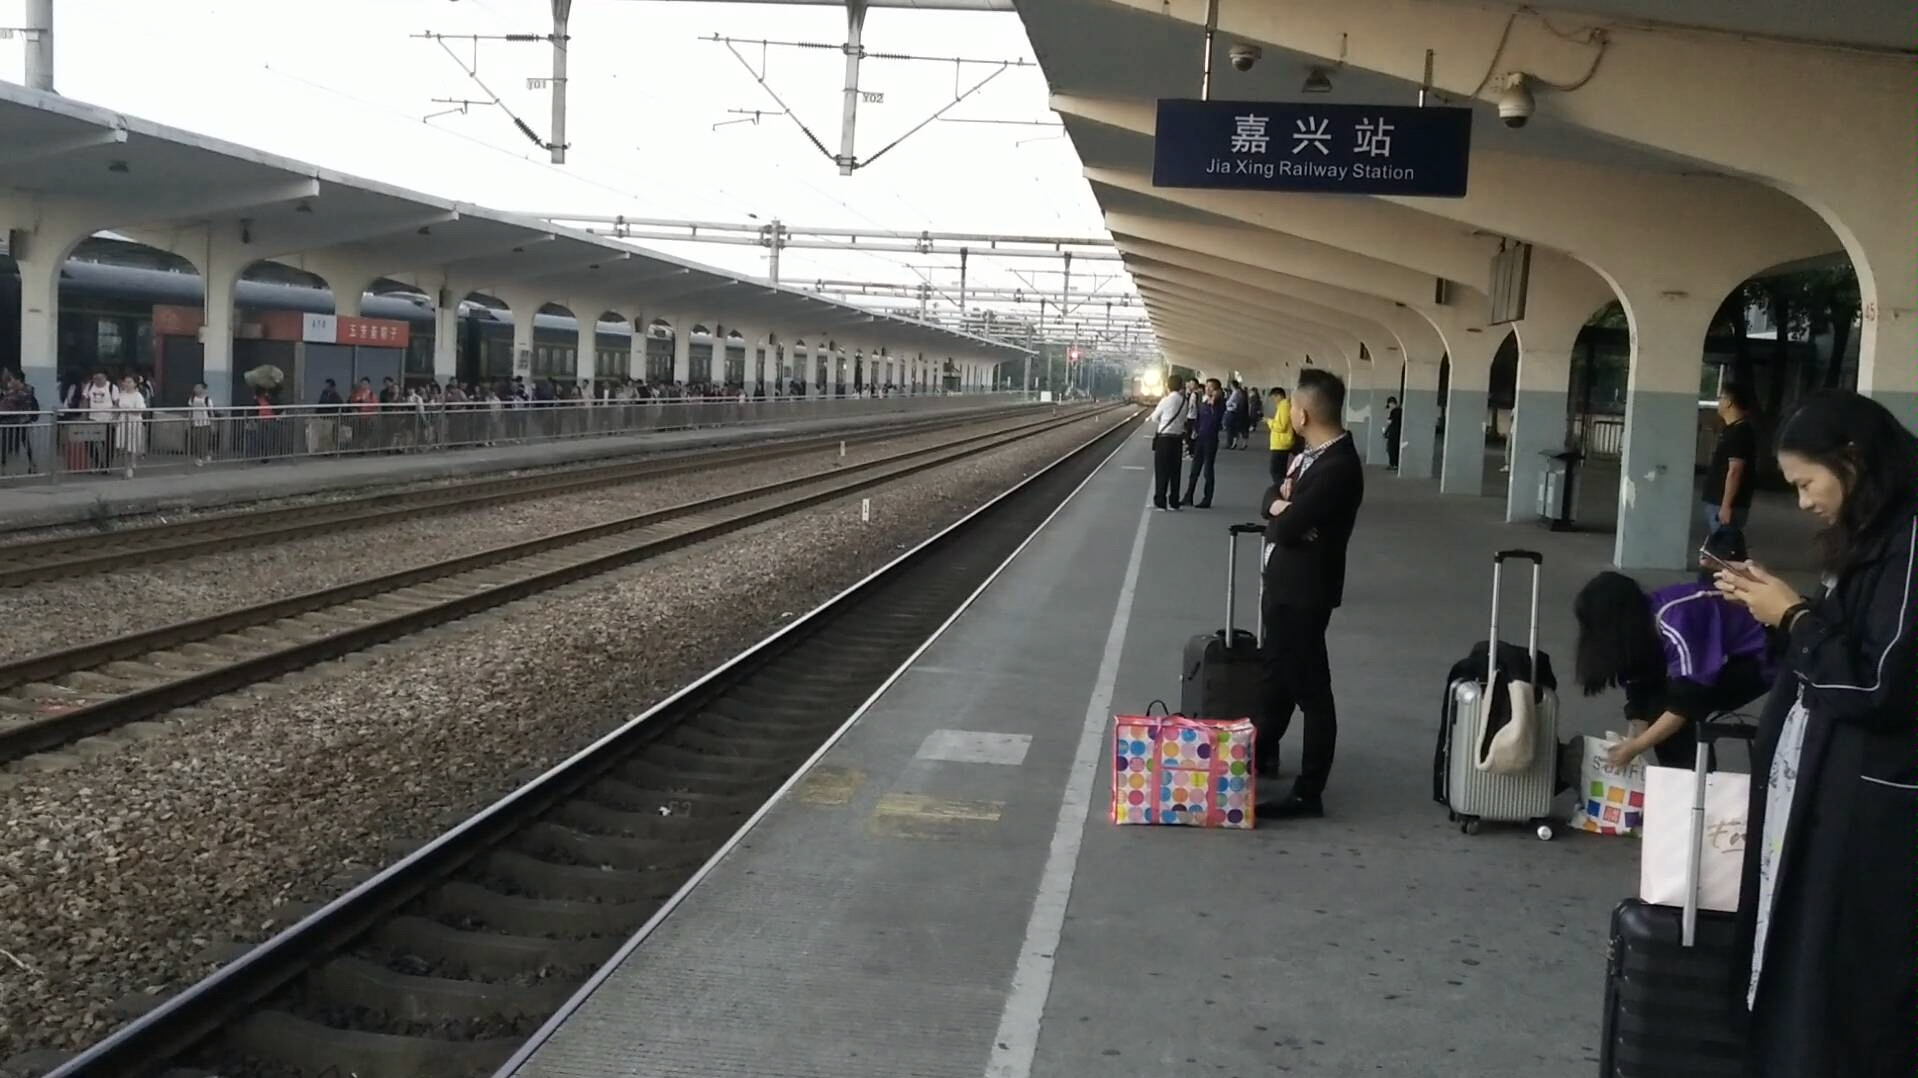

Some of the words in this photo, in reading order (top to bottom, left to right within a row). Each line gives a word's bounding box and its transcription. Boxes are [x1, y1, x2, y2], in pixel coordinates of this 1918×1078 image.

[1230, 113, 1395, 157] 嘉兴站
[1206, 158, 1231, 174] Jia
[1236, 160, 1274, 178] Xing
[1279, 161, 1347, 180] Railway
[1352, 163, 1415, 180] Station
